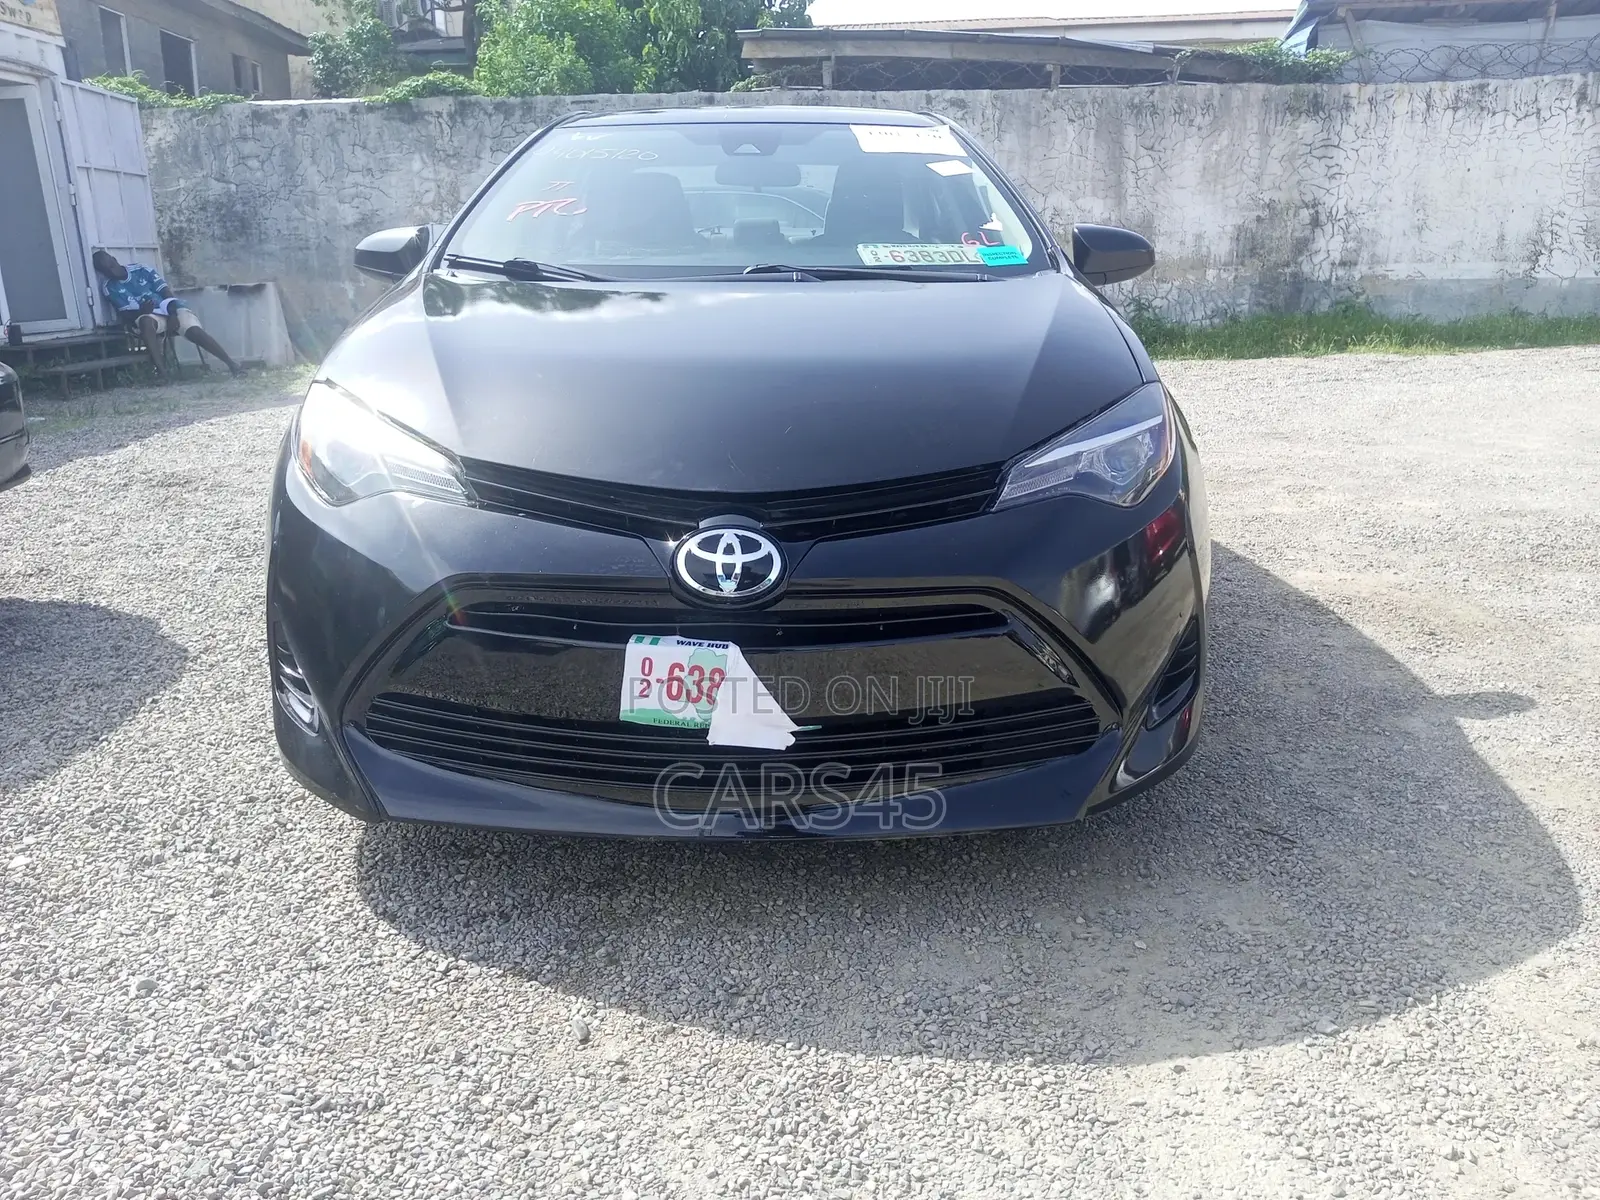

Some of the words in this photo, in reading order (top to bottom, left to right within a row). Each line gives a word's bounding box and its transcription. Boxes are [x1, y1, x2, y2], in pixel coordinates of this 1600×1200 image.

[676, 639, 705, 648] WAVE
[707, 642, 730, 650] HUB
[653, 717, 692, 728] FEDERAL
